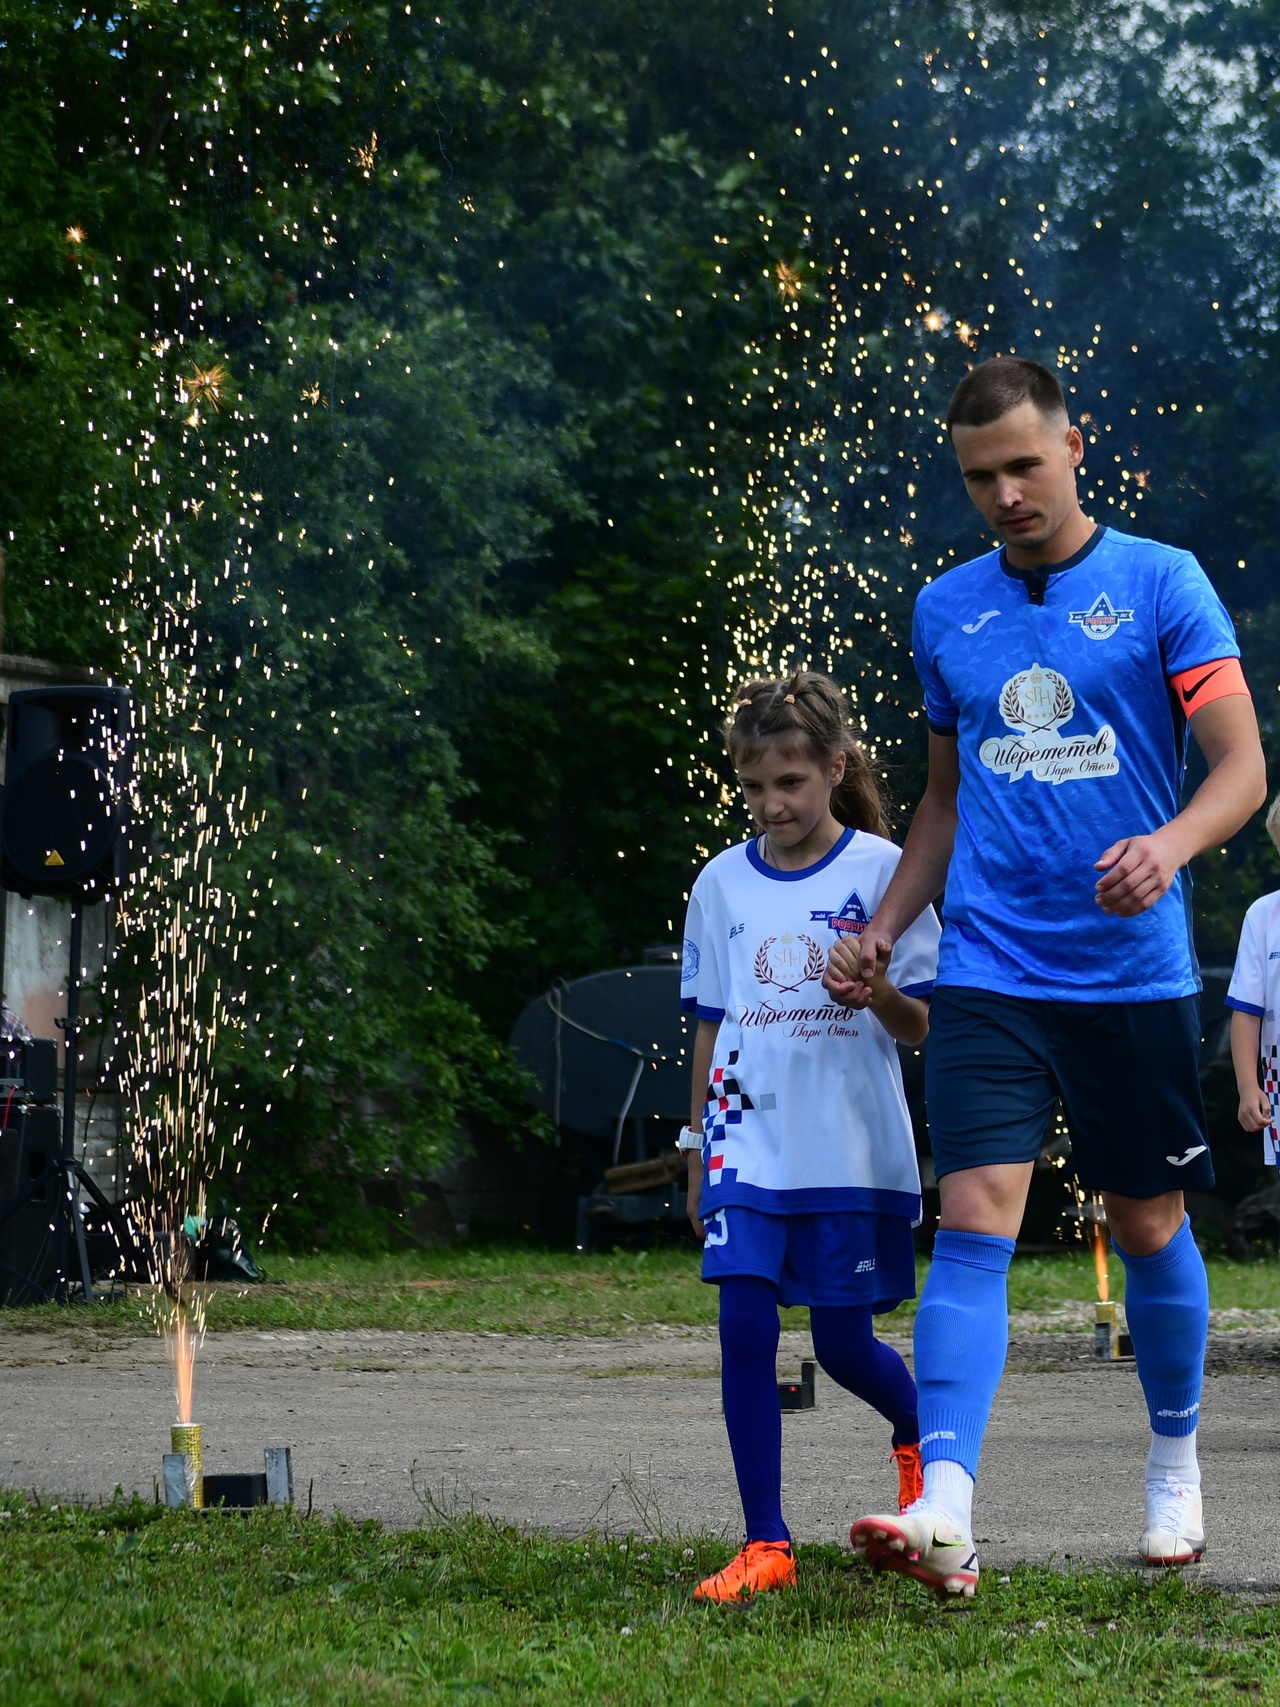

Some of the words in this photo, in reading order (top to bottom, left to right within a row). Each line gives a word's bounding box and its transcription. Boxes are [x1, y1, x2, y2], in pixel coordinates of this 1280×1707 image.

[983, 730, 1112, 772] Шереметев
[1036, 761, 1074, 780] Парк
[1079, 759, 1115, 772] Отель
[832, 918, 867, 932] РОДНИ
[783, 1022, 821, 1043] Парк
[827, 1022, 859, 1038] Отель
